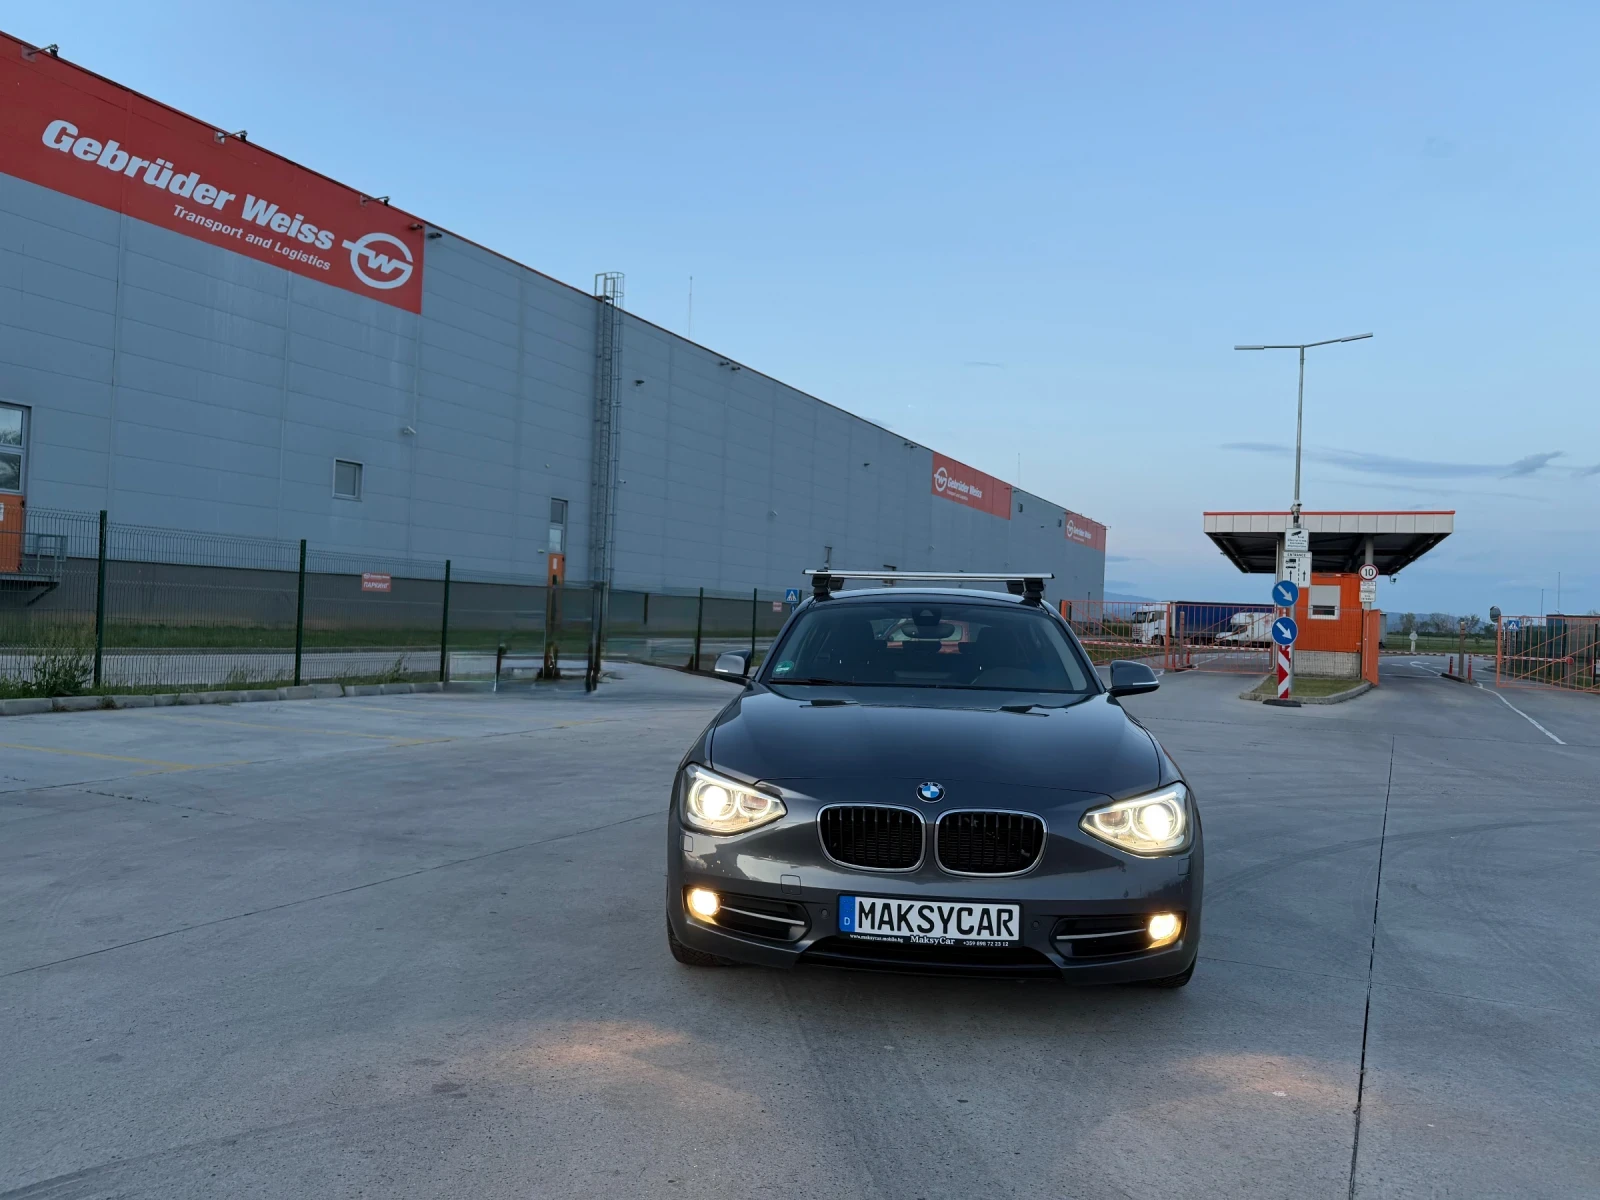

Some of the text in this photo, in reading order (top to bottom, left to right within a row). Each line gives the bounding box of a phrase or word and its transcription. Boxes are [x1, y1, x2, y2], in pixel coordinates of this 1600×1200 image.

[41, 119, 335, 250] Gebrüder Weiss
[173, 204, 331, 271] Transport and Logistics
[1364, 568, 1374, 577] 10
[844, 901, 1014, 937] D MAKSYCAR
[910, 935, 956, 945] MaksyCar
